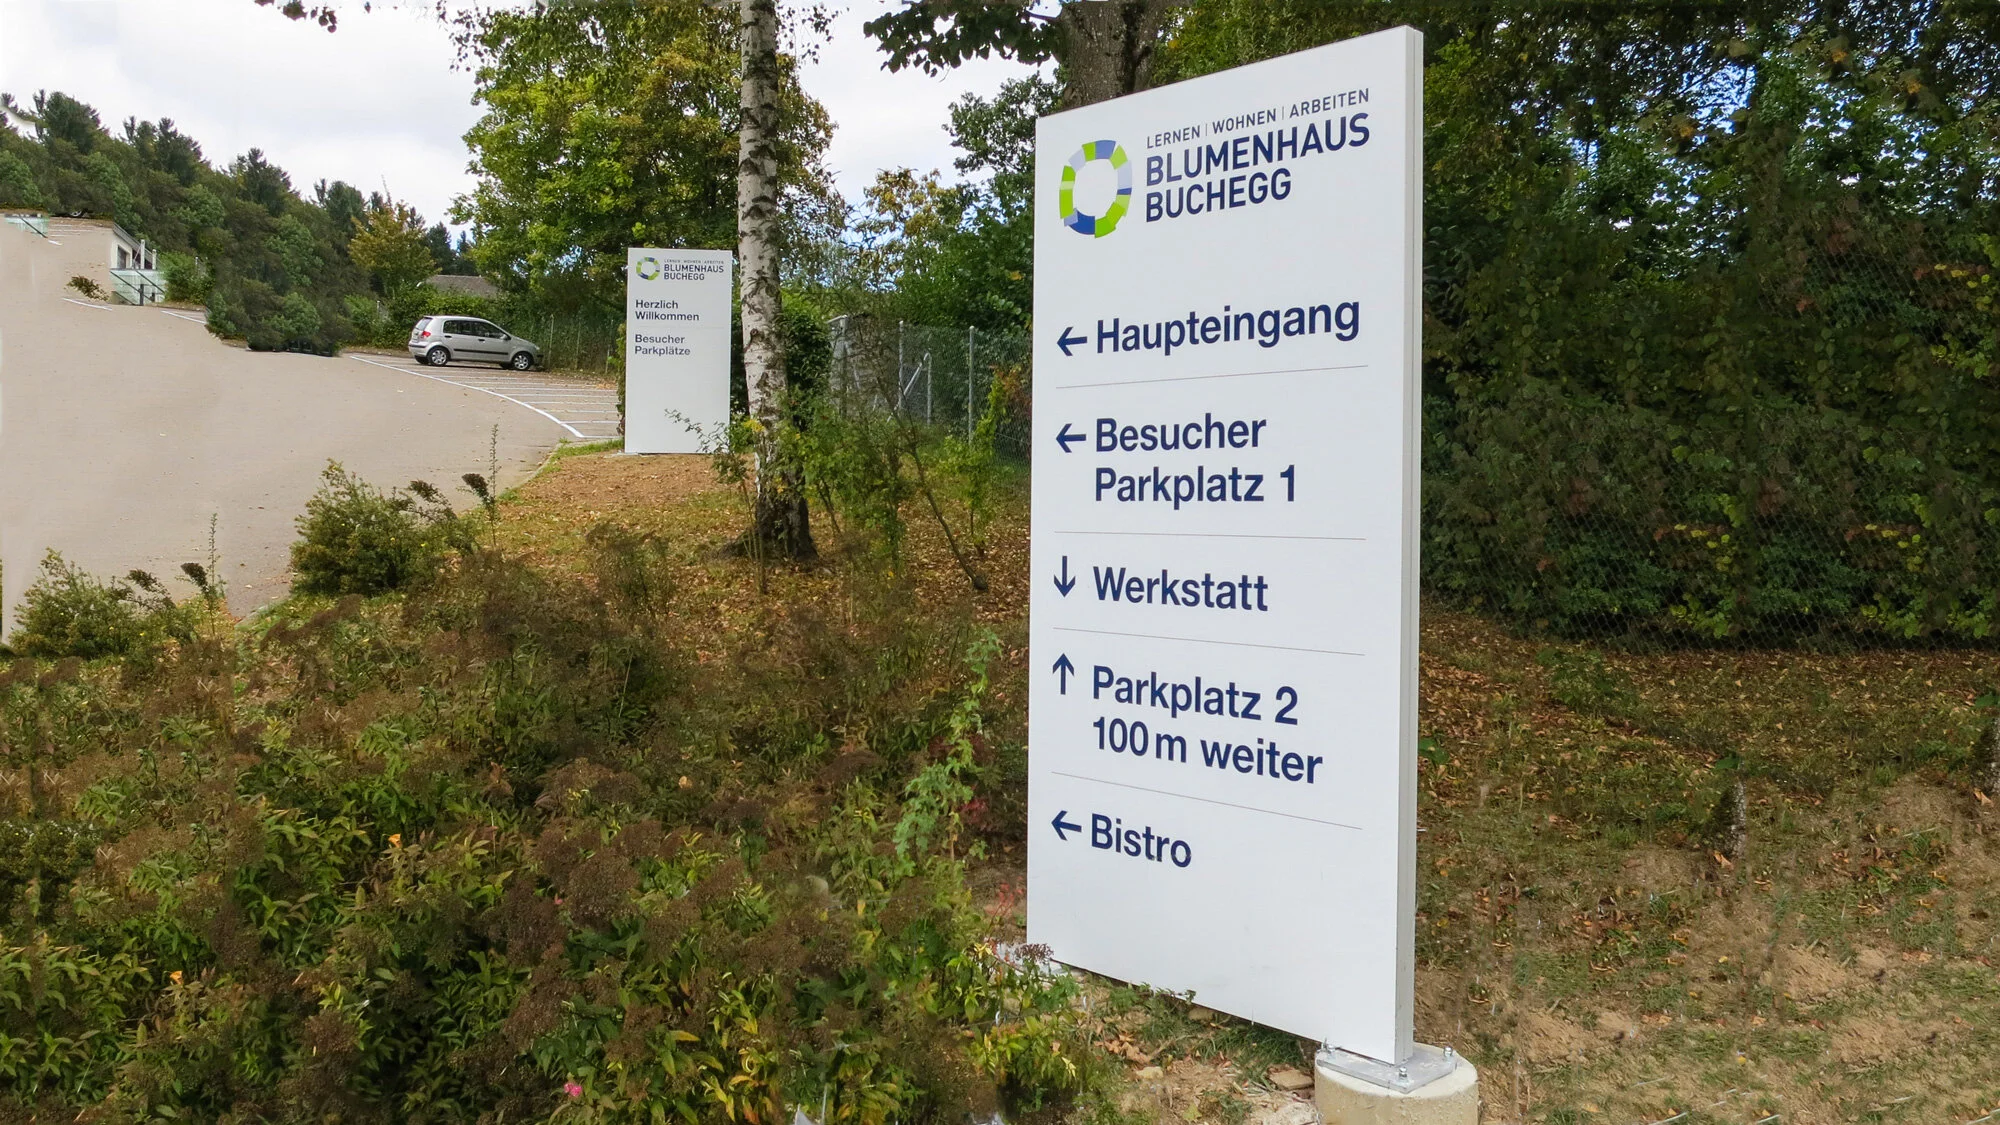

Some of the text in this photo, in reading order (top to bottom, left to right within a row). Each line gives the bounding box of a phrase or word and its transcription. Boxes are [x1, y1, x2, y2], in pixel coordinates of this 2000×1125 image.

[1147, 87, 1370, 149] LERNEN WOHNEN ARBEITEN
[1146, 112, 1370, 187] BLUMENHAUS
[1146, 168, 1292, 223] BUCHEGG
[664, 264, 724, 273] BLUMENHAUS
[664, 272, 705, 281] BUCHEGG
[635, 299, 679, 309] Herzlich
[635, 310, 700, 321] Willkommen
[634, 345, 691, 356] Parkplätze
[635, 333, 685, 344] Besucher
[1096, 301, 1360, 357] Haupteingang
[1095, 412, 1267, 453] Besucher
[1095, 464, 1296, 511] Parkplatz 1
[1092, 565, 1269, 612] Werkstatt
[1093, 664, 1299, 726] Parkplatz 2
[1092, 716, 1149, 757] 100
[1199, 737, 1324, 785] weiter
[1091, 812, 1192, 868] Bistro
